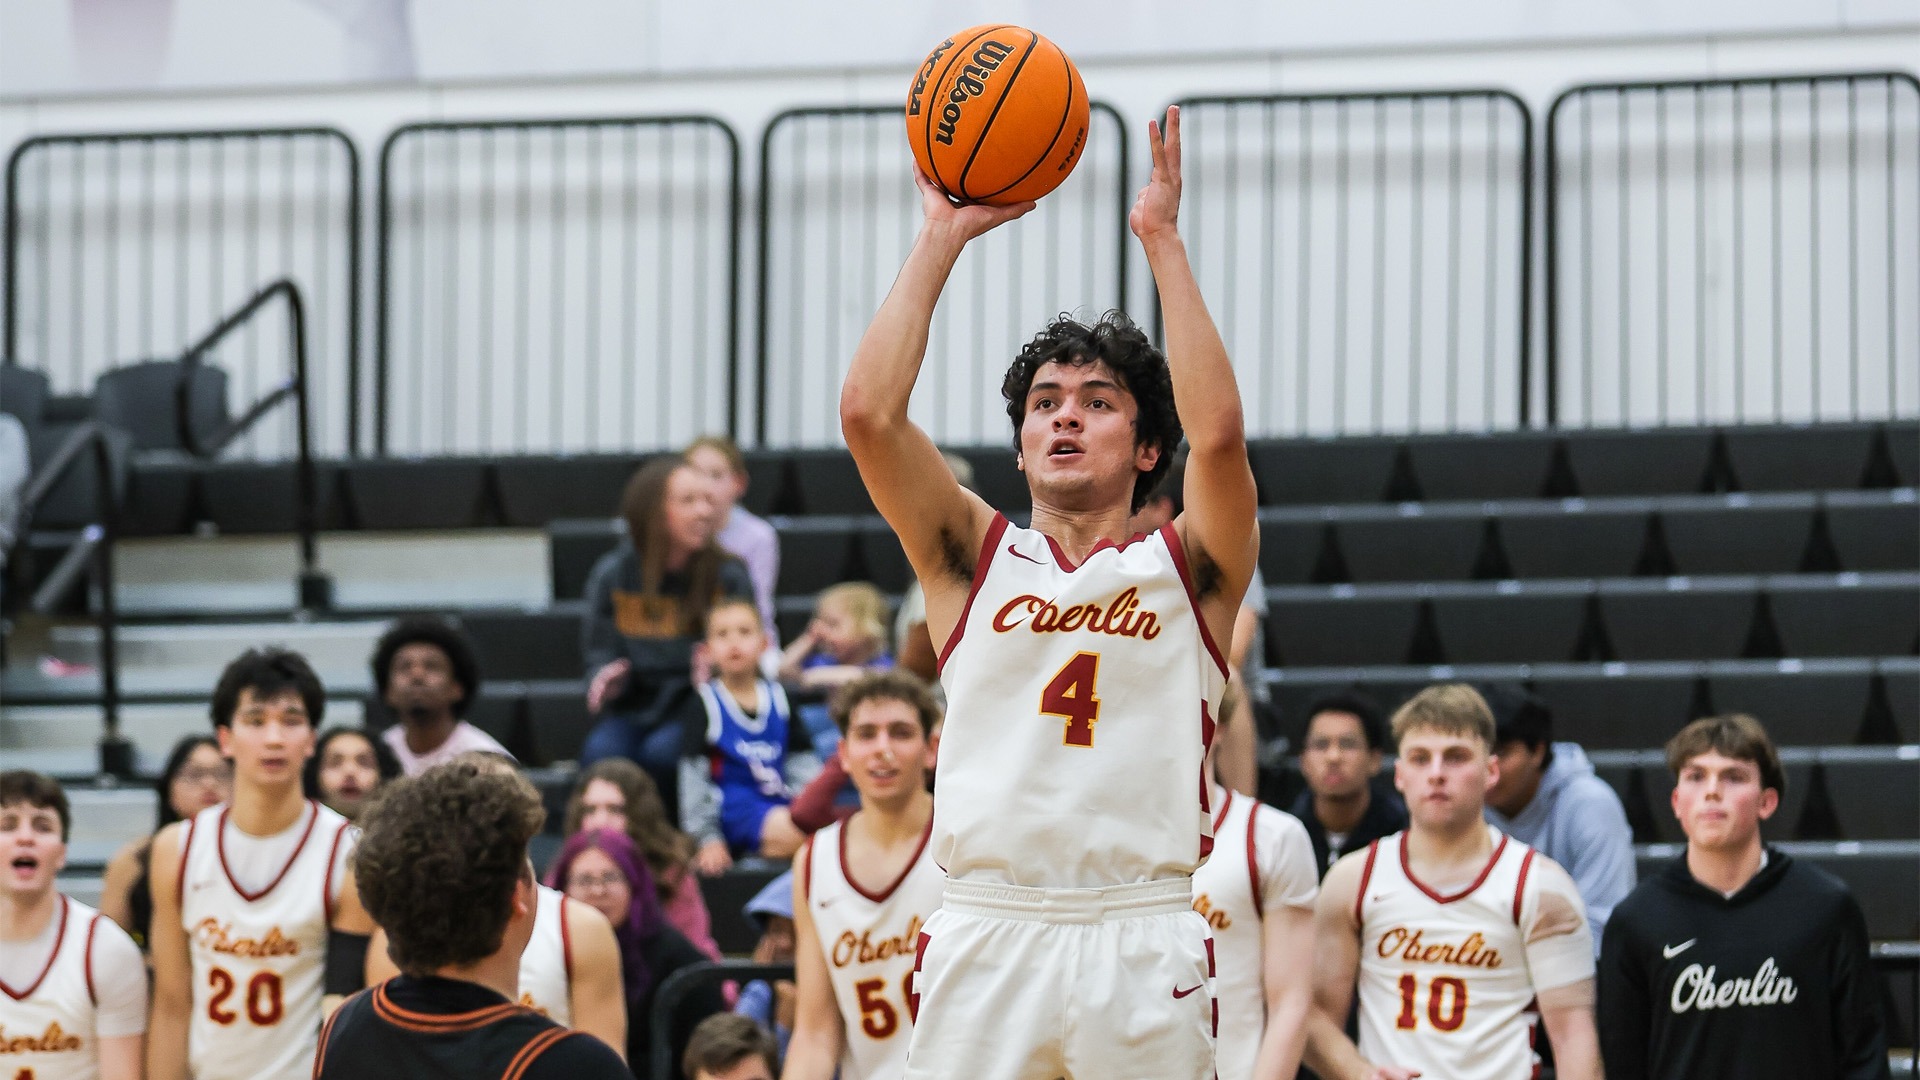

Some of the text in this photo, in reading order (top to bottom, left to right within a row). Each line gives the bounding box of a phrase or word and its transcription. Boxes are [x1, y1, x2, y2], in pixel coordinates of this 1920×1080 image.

[909, 38, 955, 117] NCAA
[936, 40, 1016, 146] Wilson
[1039, 650, 1101, 749] 4
[832, 914, 922, 968] Oberl
[1376, 926, 1502, 970] Oberlin
[208, 966, 285, 1026] 20
[1395, 972, 1469, 1032] 10
[1671, 956, 1798, 1015] Oberlin
